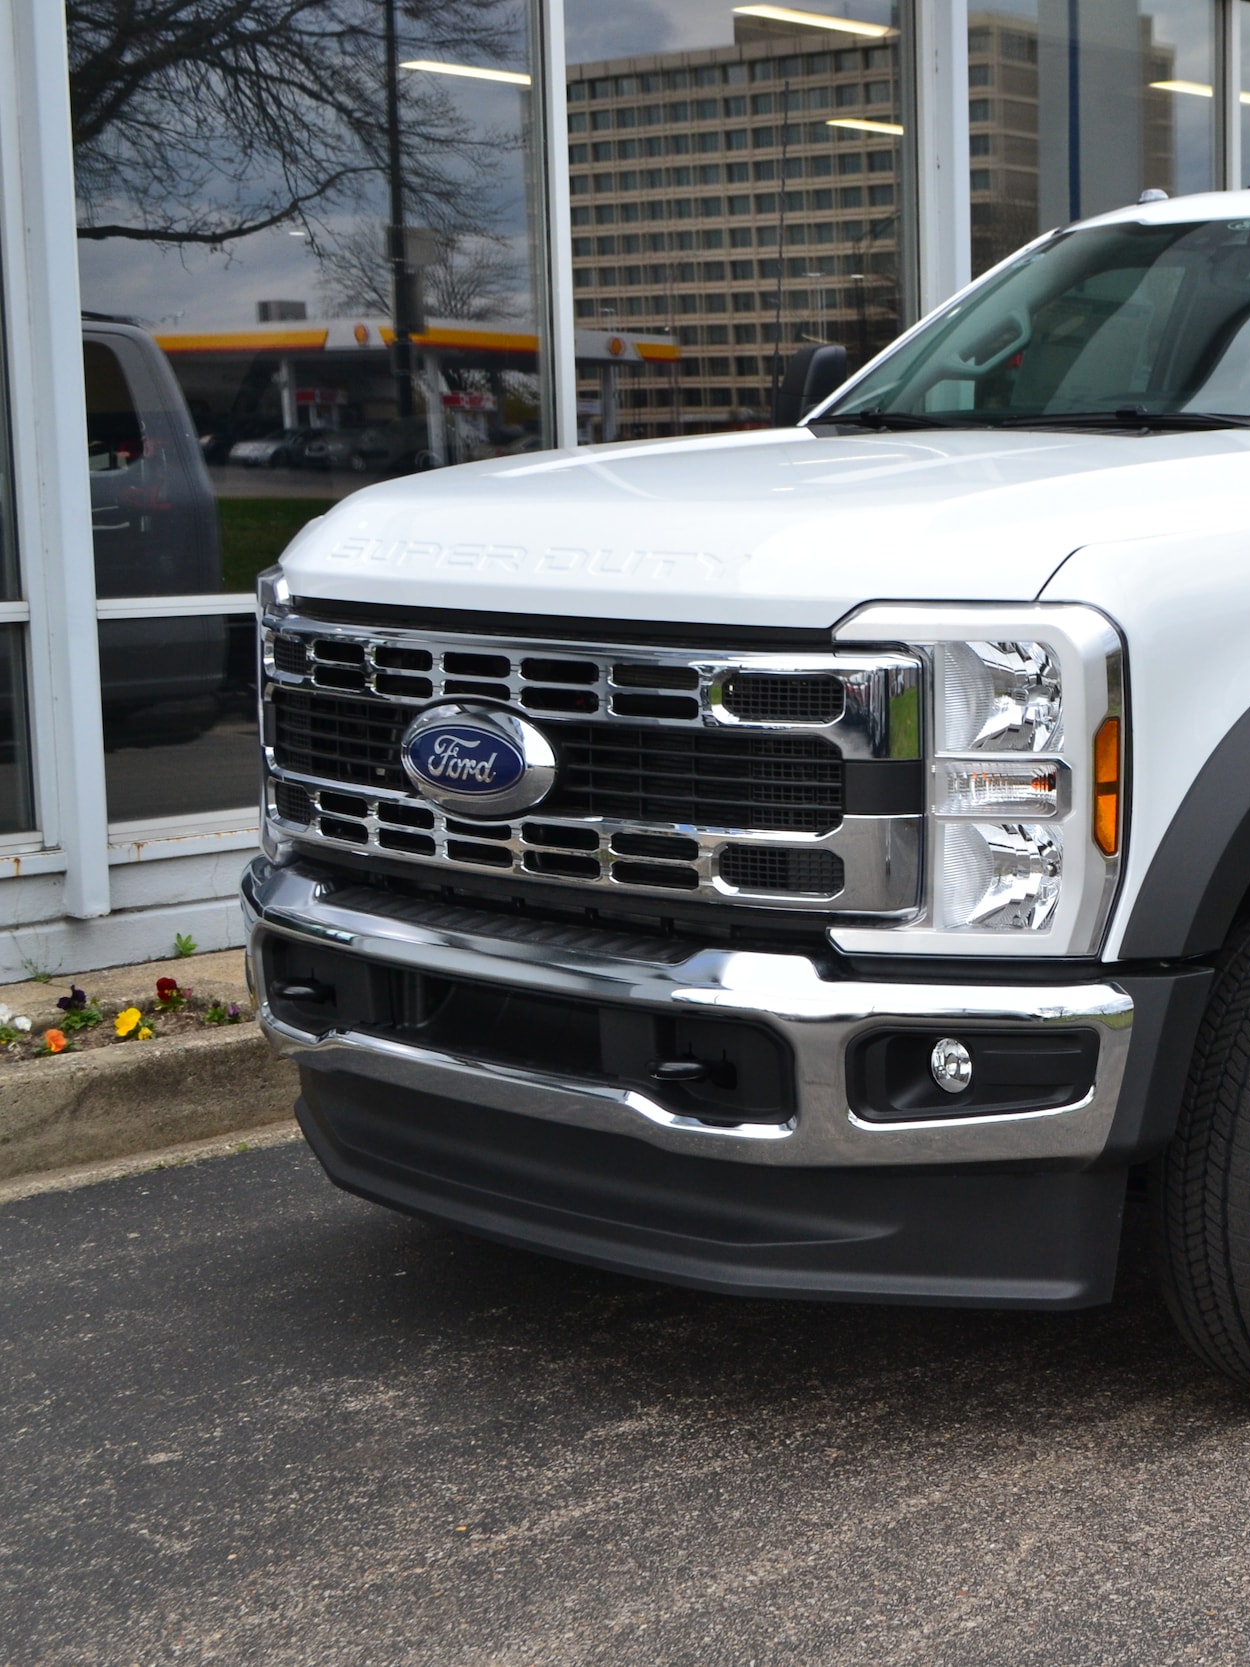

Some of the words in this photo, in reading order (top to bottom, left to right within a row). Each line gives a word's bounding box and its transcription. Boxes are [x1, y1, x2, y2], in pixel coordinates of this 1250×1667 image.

[328, 537, 528, 571] SUPER
[535, 546, 753, 582] DUTY
[428, 735, 498, 783] Ford
